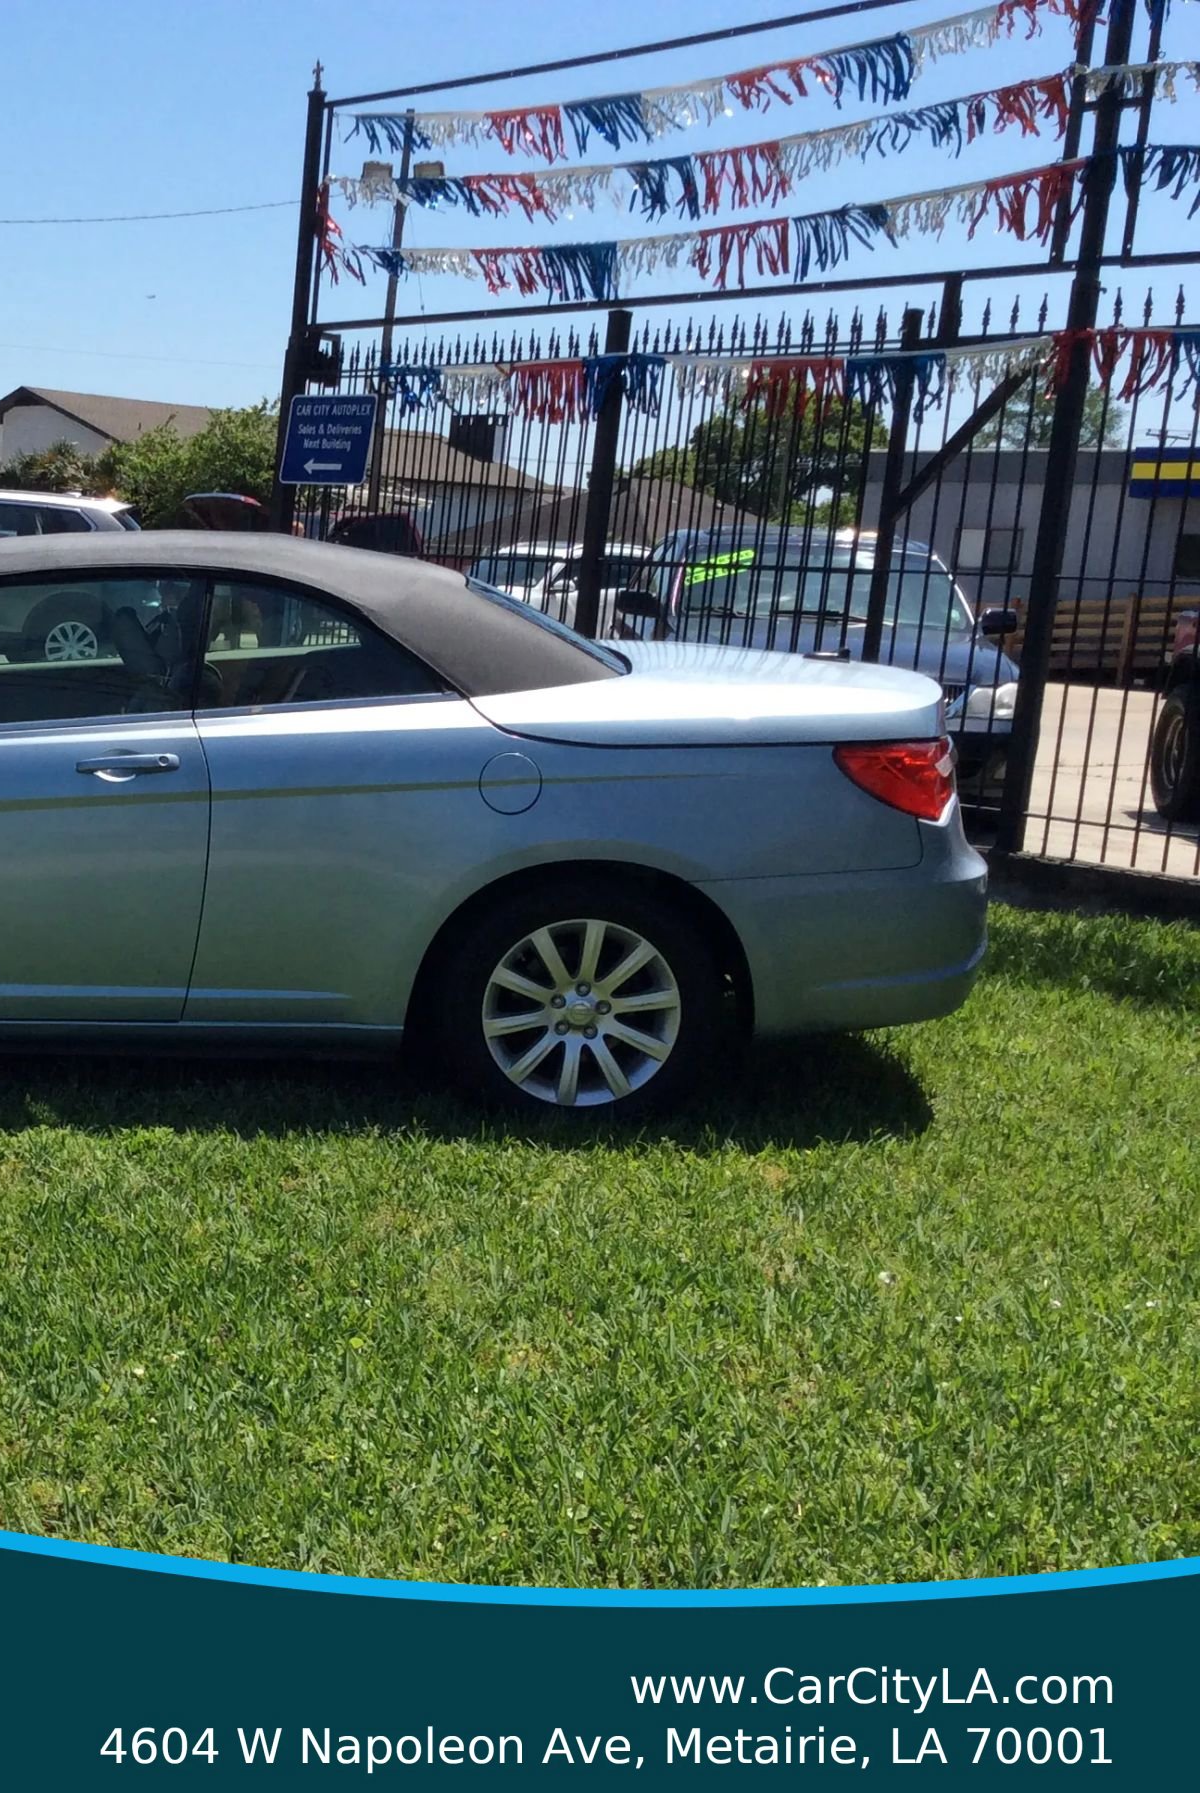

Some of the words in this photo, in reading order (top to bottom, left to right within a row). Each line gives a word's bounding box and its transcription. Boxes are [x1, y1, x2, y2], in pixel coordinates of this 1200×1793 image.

[296, 404, 312, 416] CAR
[313, 404, 331, 416] CITY
[331, 404, 372, 416] AUTOPLEX
[297, 423, 316, 435] Sales
[318, 424, 325, 435] &
[326, 423, 362, 435] Deliveries
[303, 438, 320, 449] Next
[321, 439, 352, 452] Building
